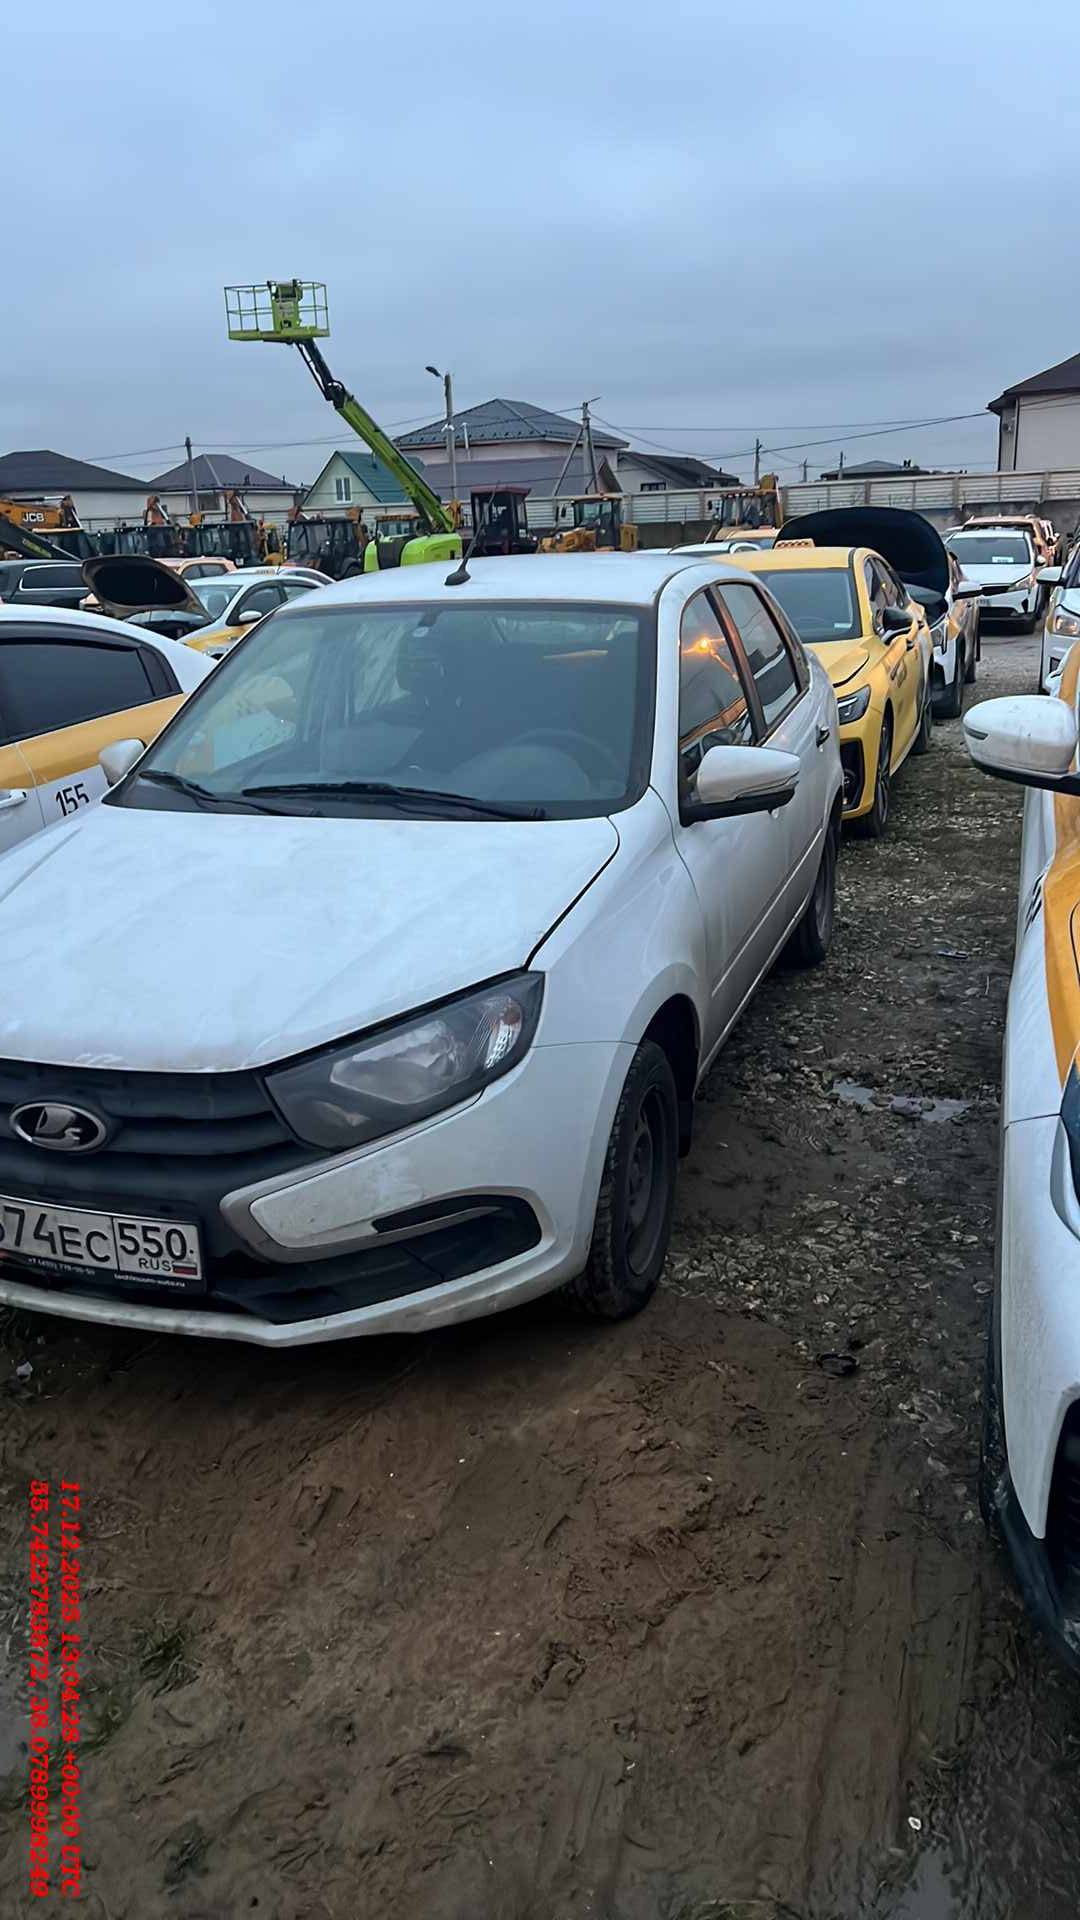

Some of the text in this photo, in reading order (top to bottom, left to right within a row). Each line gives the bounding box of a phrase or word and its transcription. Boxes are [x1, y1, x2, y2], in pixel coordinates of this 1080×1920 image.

[22, 512, 45, 522] JCB
[55, 782, 90, 816] 155
[0, 1204, 188, 1263] 74EC 550
[138, 1257, 172, 1272] RUS
